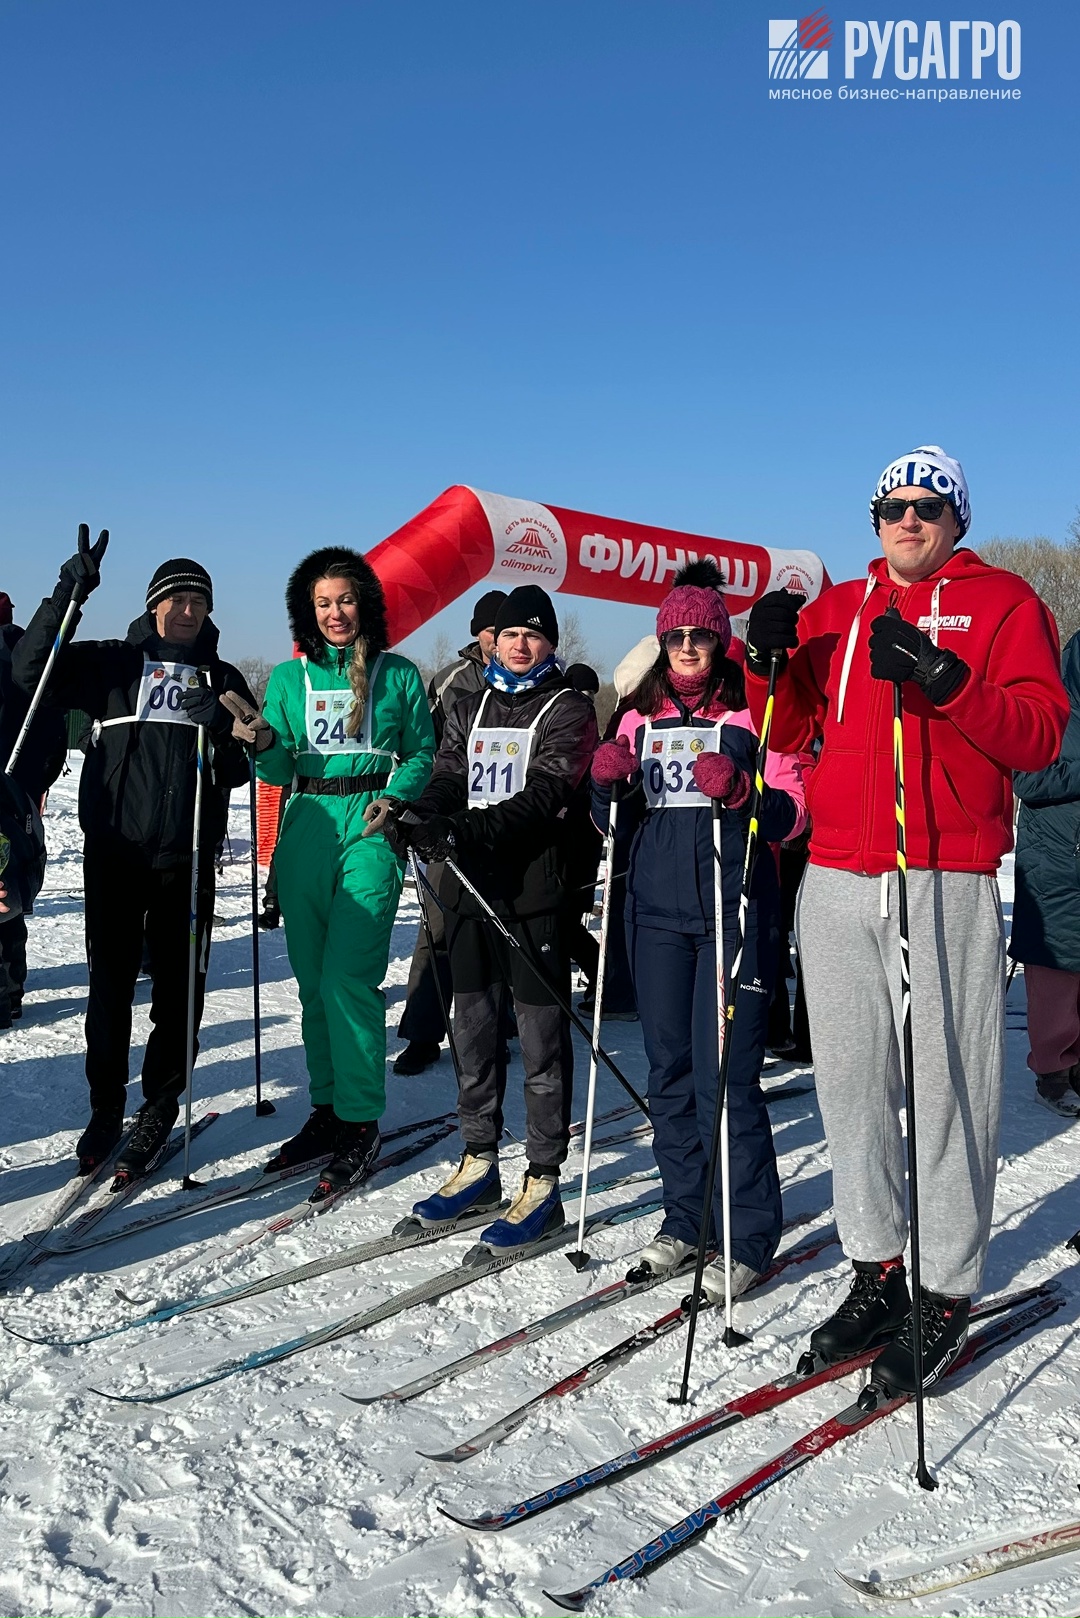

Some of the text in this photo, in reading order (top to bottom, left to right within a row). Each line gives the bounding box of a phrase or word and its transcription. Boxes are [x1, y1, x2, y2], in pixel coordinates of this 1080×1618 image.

[505, 517, 558, 544] СЕТЬ МАГАЗИНОВ
[505, 544, 552, 560] ОЛИМП
[500, 559, 557, 575] olimpvl.ru
[938, 615, 972, 628] УСАГРО
[149, 685, 183, 711] 00
[471, 761, 513, 793] 211
[650, 760, 703, 794] 032
[415, 1223, 457, 1241] JARVINEN
[486, 1251, 525, 1272] JARVINEN
[921, 1332, 968, 1391] SPINE
